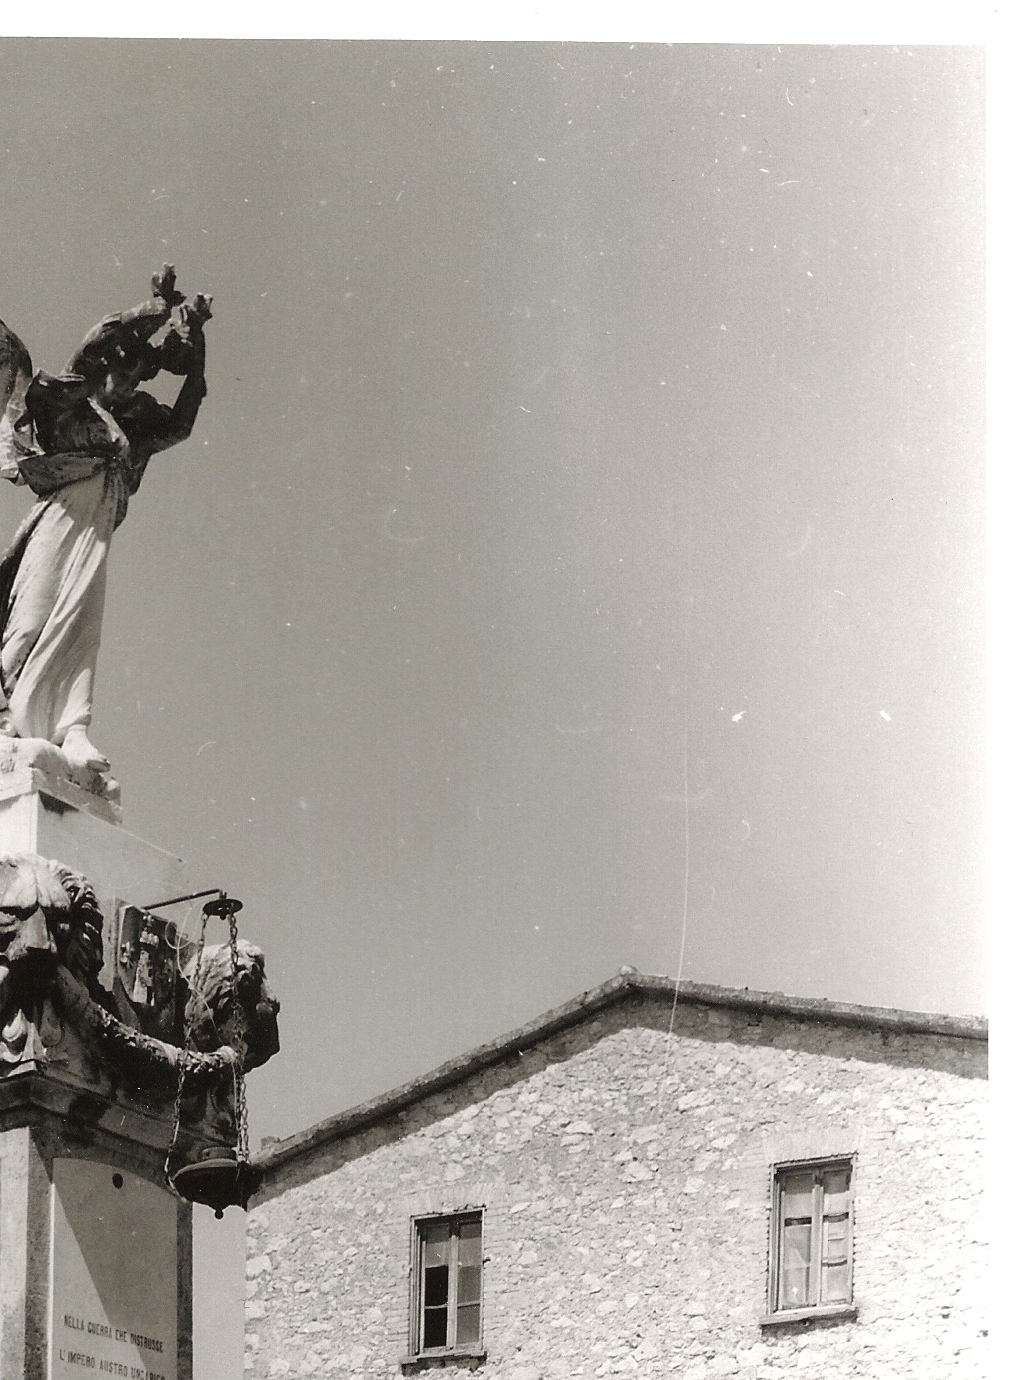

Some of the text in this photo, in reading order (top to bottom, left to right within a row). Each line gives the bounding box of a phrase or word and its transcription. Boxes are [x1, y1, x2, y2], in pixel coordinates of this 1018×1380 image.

[64, 1315, 84, 1330] NELLA
[115, 1329, 127, 1343] CHE
[130, 1334, 163, 1352] DISTRUSSE
[99, 1360, 127, 1376] AUSTRO
